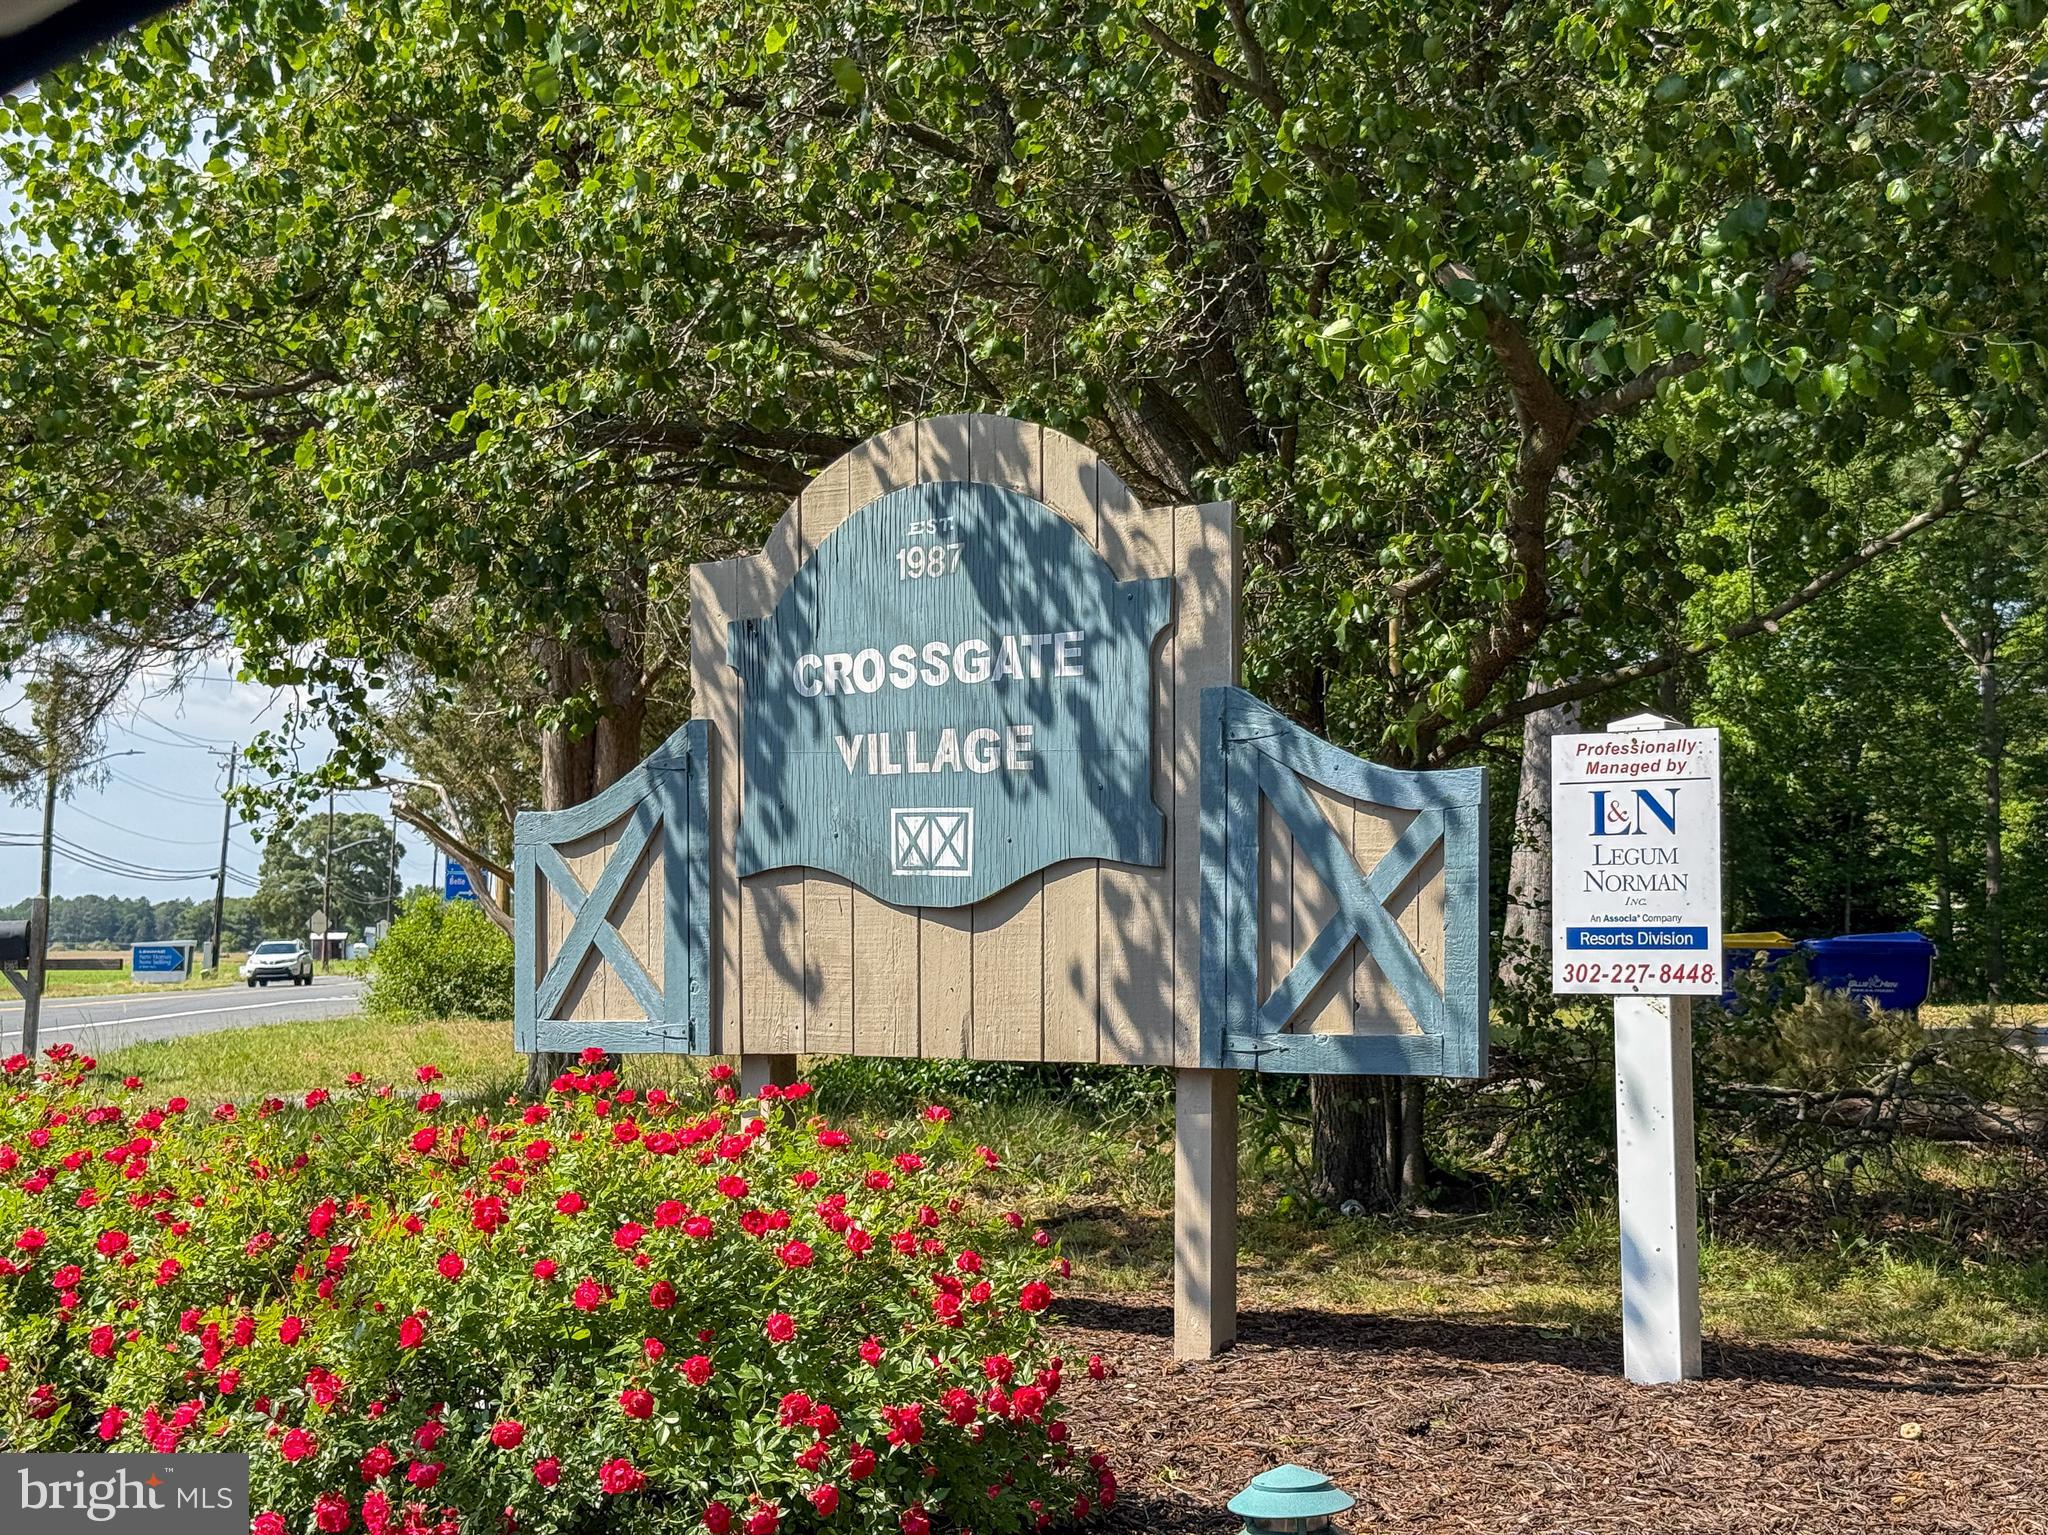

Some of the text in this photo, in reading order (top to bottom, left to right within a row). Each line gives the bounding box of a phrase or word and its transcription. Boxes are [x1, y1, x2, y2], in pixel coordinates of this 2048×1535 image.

[896, 543, 964, 581] 1987
[792, 630, 1086, 698] CROSSGATE
[834, 725, 1035, 776] VILLAGE
[1576, 738, 1697, 757] Professionally
[1586, 758, 1687, 776] Managed by
[1588, 788, 1681, 837] L&N
[1592, 844, 1680, 866] LEGUM
[1583, 870, 1689, 893] NORMAN
[1590, 914, 1602, 922] An
[1643, 913, 1682, 925] Company
[1580, 931, 1693, 946] Resorts Division
[1562, 963, 1714, 985] 302-227-8448
